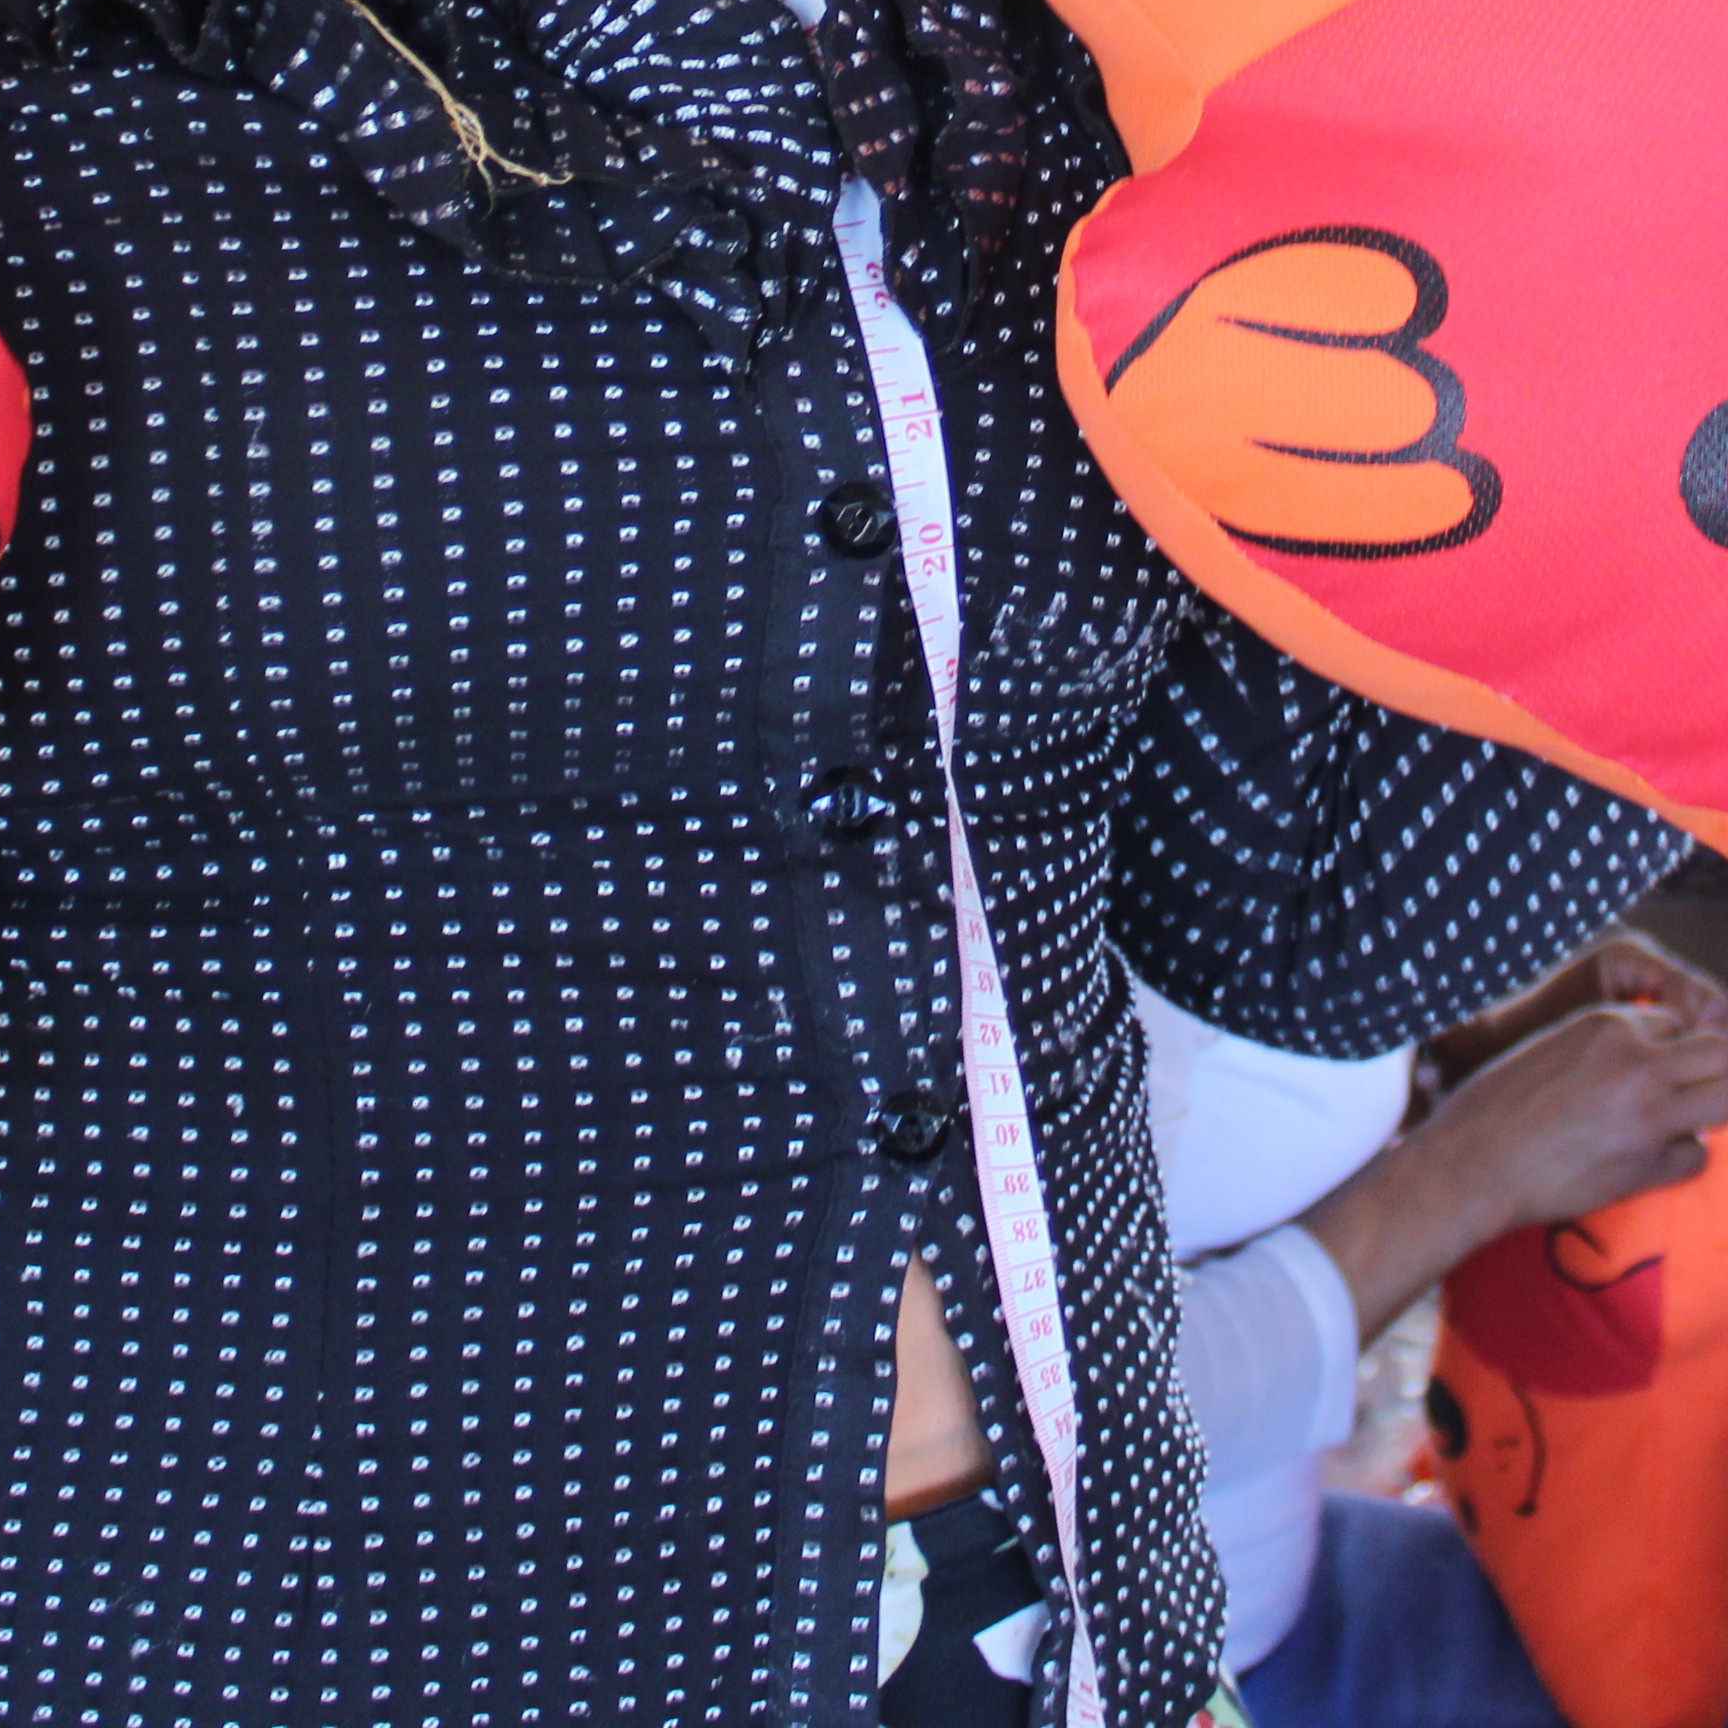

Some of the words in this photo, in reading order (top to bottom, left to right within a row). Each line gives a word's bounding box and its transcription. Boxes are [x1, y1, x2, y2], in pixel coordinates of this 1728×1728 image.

[901, 388, 933, 442] 21
[920, 522, 947, 577] 20
[979, 1023, 1004, 1047] 42
[988, 1072, 1013, 1096] 41
[994, 1122, 1020, 1147] 40
[1004, 1171, 1031, 1196] 39
[1012, 1217, 1040, 1243] 38
[1022, 1268, 1047, 1294] 37
[1030, 1316, 1054, 1340] 36
[1040, 1365, 1062, 1391] 35
